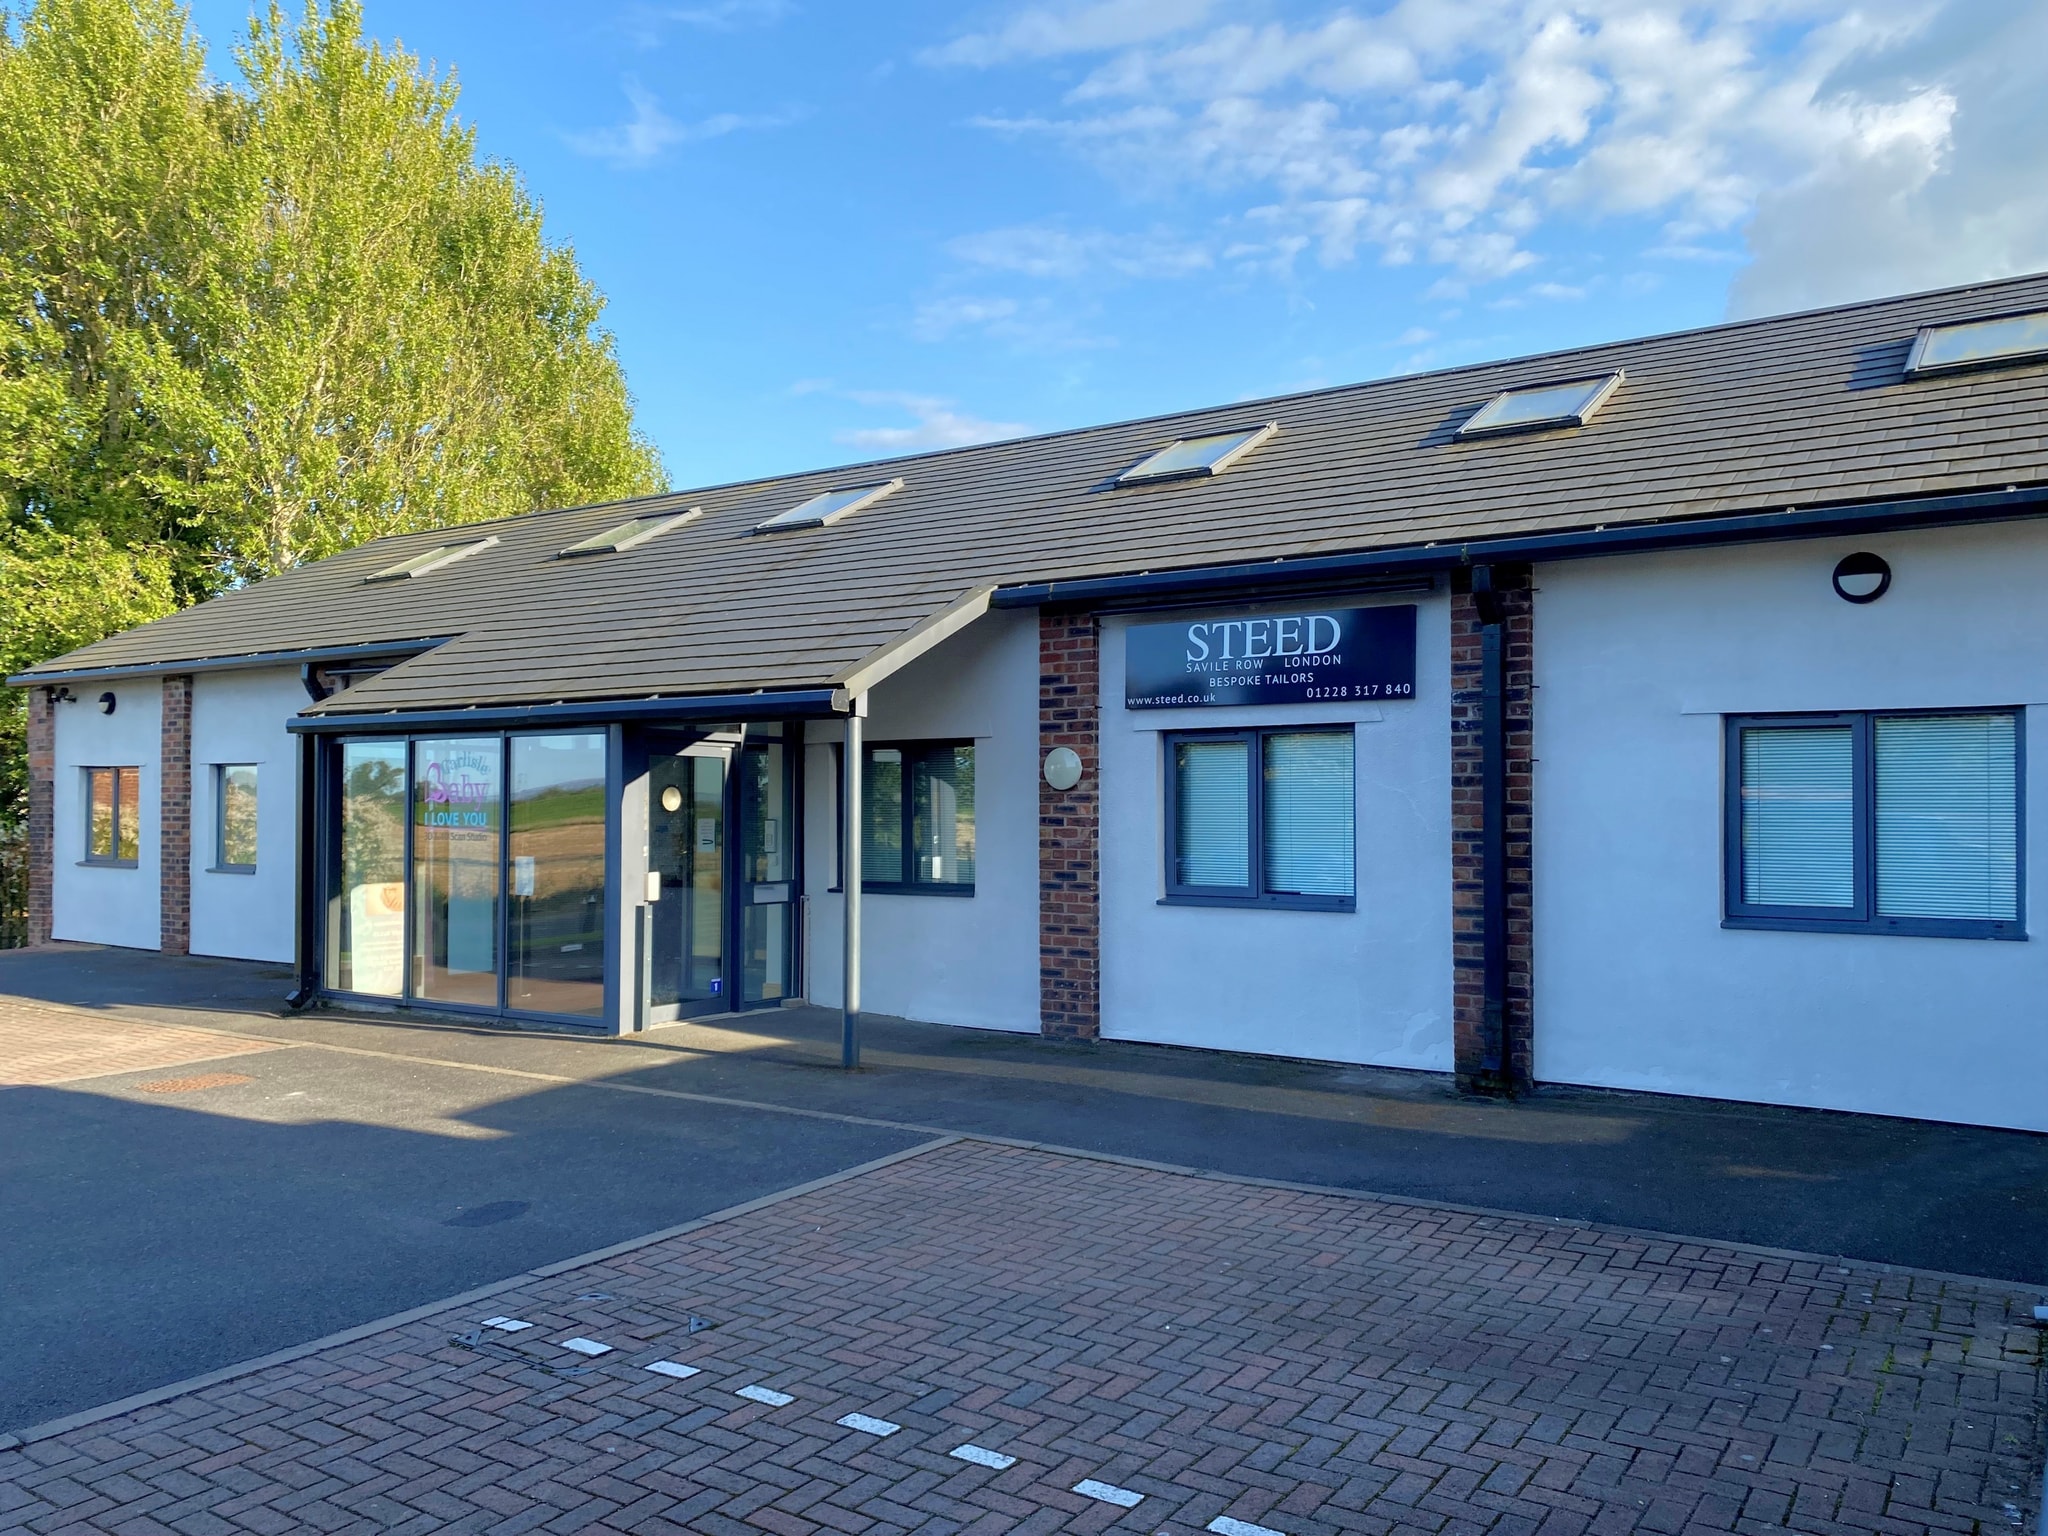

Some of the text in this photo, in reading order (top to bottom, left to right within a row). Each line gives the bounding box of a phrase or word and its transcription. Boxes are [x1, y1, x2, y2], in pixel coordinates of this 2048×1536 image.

[1186, 615, 1341, 662] STEED
[1186, 654, 1342, 673] SAVILE ROW LONDON
[1209, 673, 1314, 687] BESPOKE TAILORS
[1306, 683, 1410, 698] 01228 317 840
[1127, 693, 1216, 705] www.steed.co.uk
[424, 762, 490, 811] Baby
[431, 812, 459, 826] LOVE
[463, 812, 486, 826] YOU
